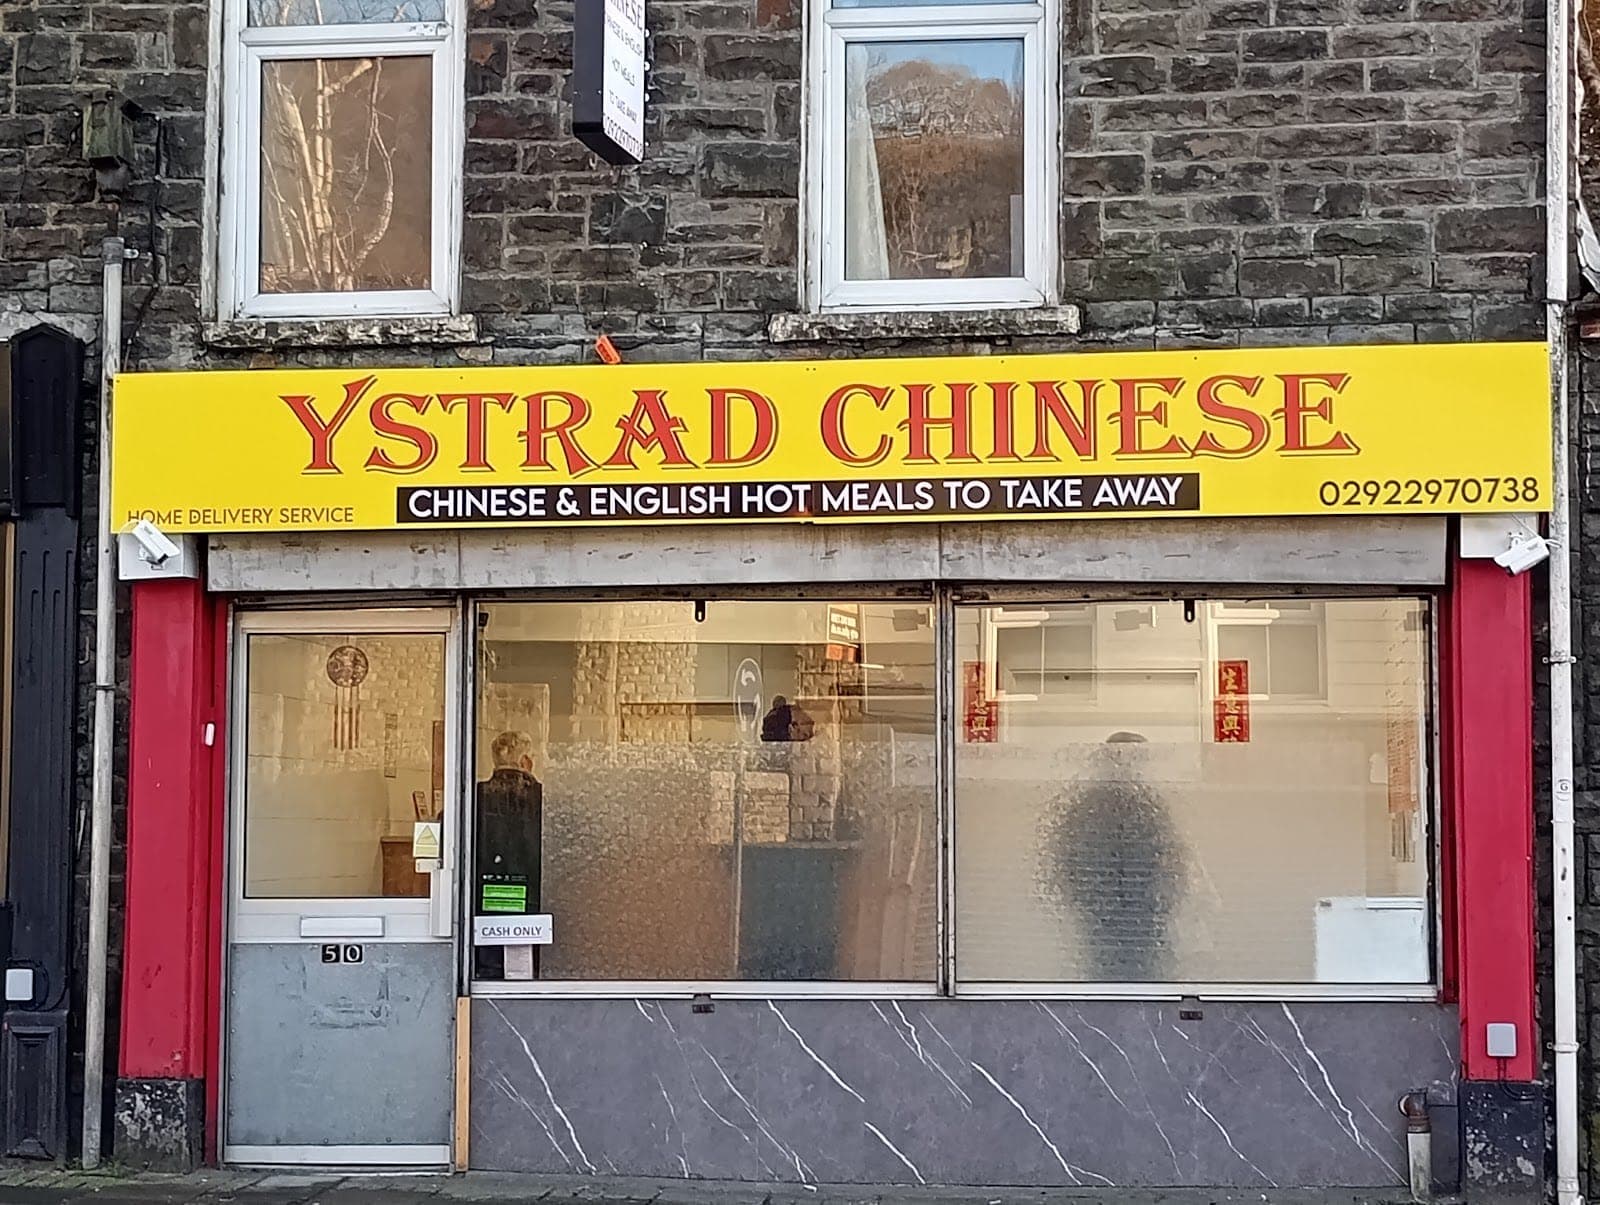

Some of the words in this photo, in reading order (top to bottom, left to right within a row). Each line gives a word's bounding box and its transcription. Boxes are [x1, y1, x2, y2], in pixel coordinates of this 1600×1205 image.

[279, 375, 779, 478] YSTRAD
[820, 373, 1361, 467] CHINESE
[408, 489, 546, 517] CHINESE
[556, 487, 580, 516] &
[591, 485, 730, 515] ENGLISH
[742, 484, 811, 513] HOT
[822, 481, 935, 512] MEALS
[943, 481, 991, 509] TO
[1000, 479, 1082, 509] TAKE
[1092, 477, 1184, 507] AWAY
[1319, 477, 1540, 506] 02922970738
[128, 509, 183, 524] HOME
[189, 508, 273, 524] DELIVERY
[279, 507, 354, 523] SERVICE
[481, 926, 510, 937] CASH
[513, 926, 542, 937] ONLY
[325, 945, 360, 962] 50
